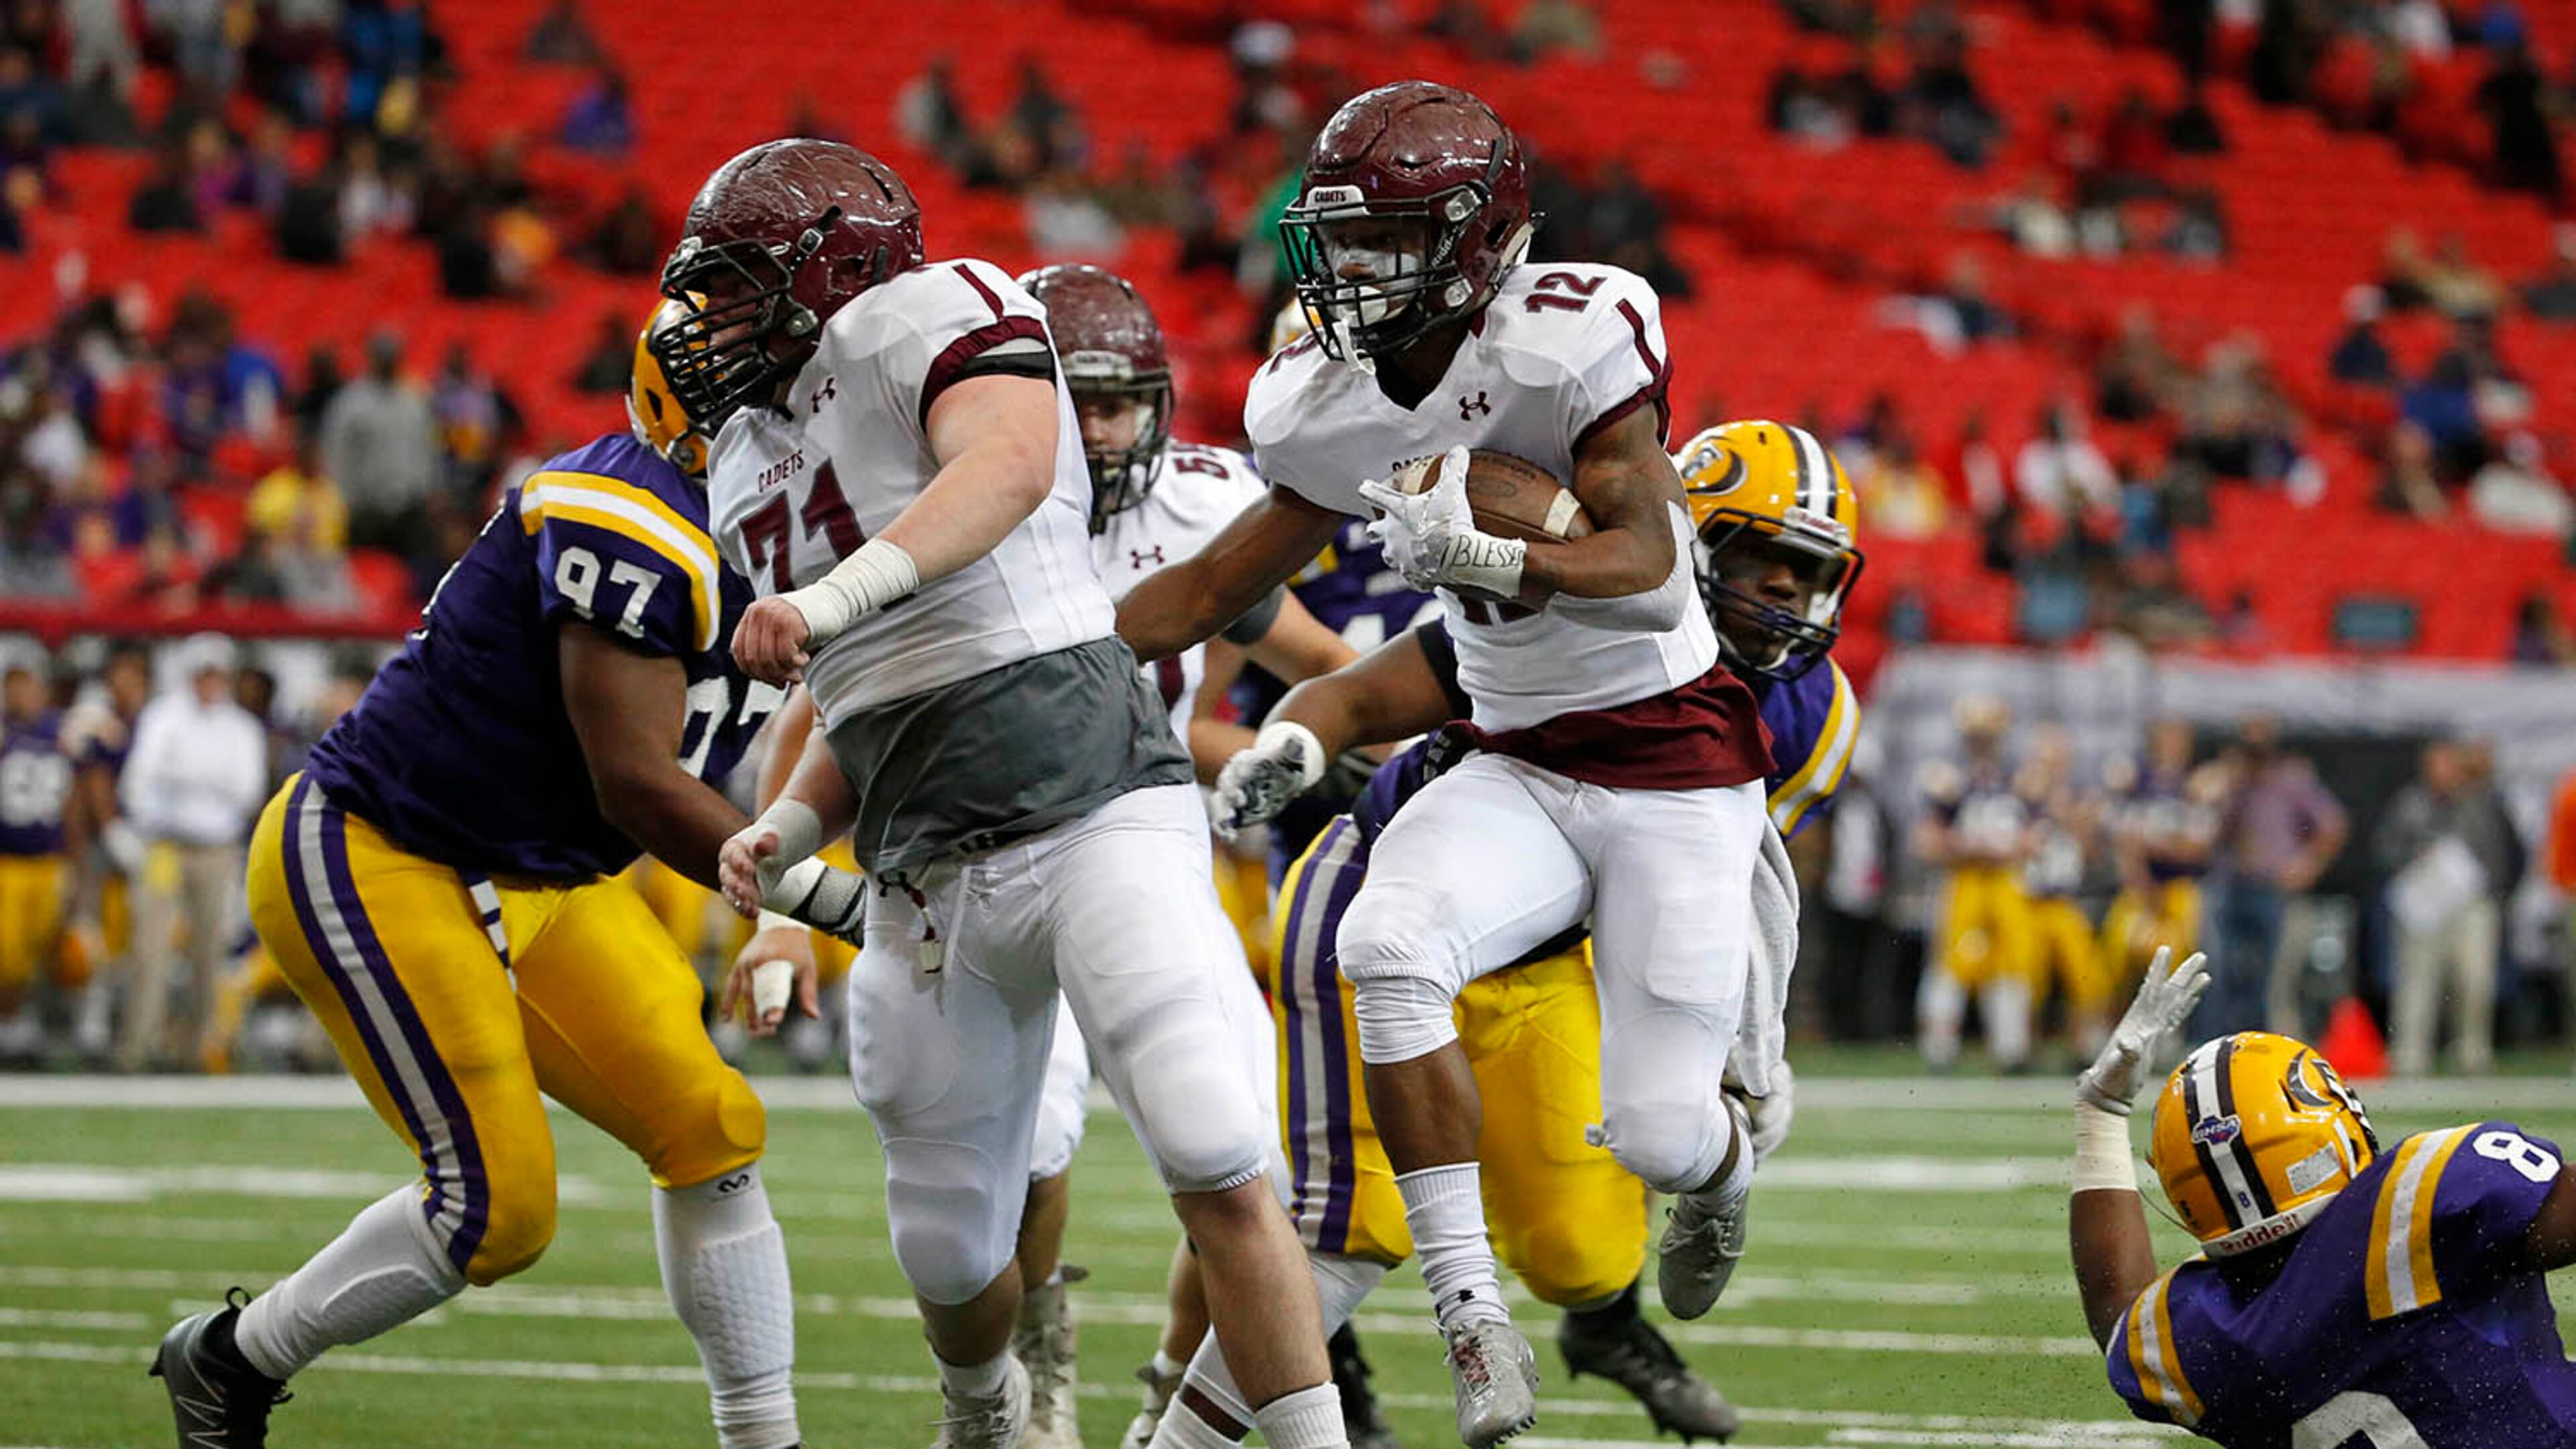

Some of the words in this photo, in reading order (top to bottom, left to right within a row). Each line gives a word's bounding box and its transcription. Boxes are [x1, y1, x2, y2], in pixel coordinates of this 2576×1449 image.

[1523, 272, 1608, 313] 12
[758, 449, 804, 493] CADETS
[739, 456, 868, 594] 71
[554, 545, 662, 639] 97
[2473, 1131, 2561, 1183] 8
[2238, 1190, 2251, 1209] 8
